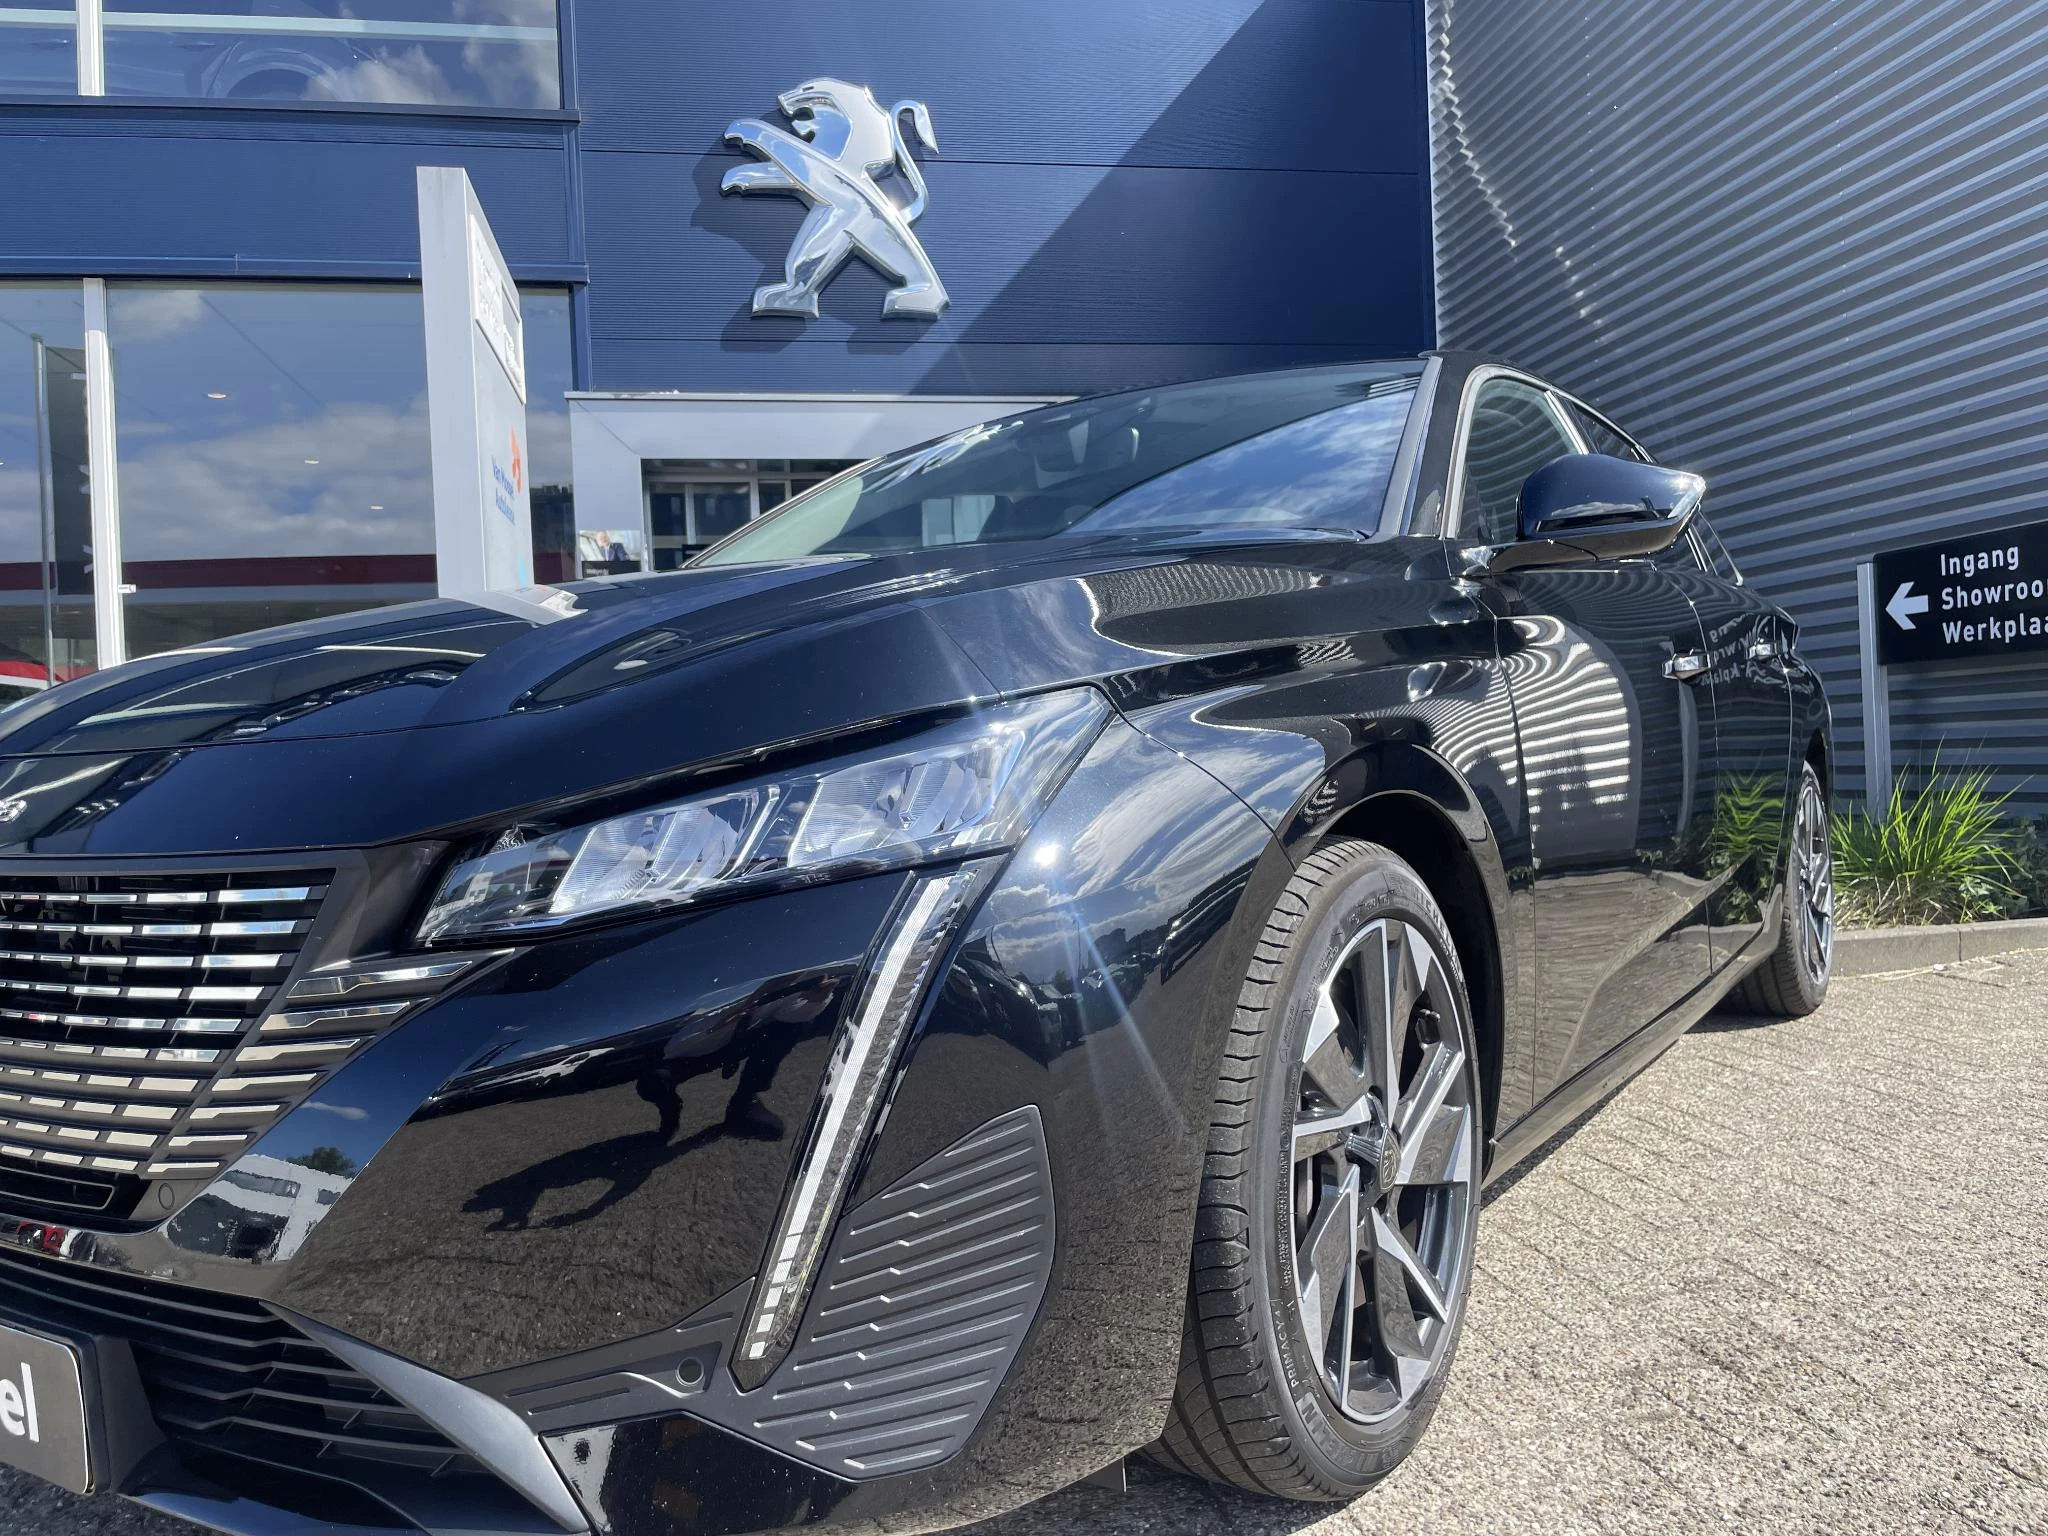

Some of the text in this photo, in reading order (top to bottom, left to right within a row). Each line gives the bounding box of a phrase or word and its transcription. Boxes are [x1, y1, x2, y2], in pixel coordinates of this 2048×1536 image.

[1940, 546, 2020, 577] Ingang
[1941, 578, 2048, 610] Showroo
[1276, 1319, 1301, 1389] PRIMACY
[0, 1361, 40, 1443] el
